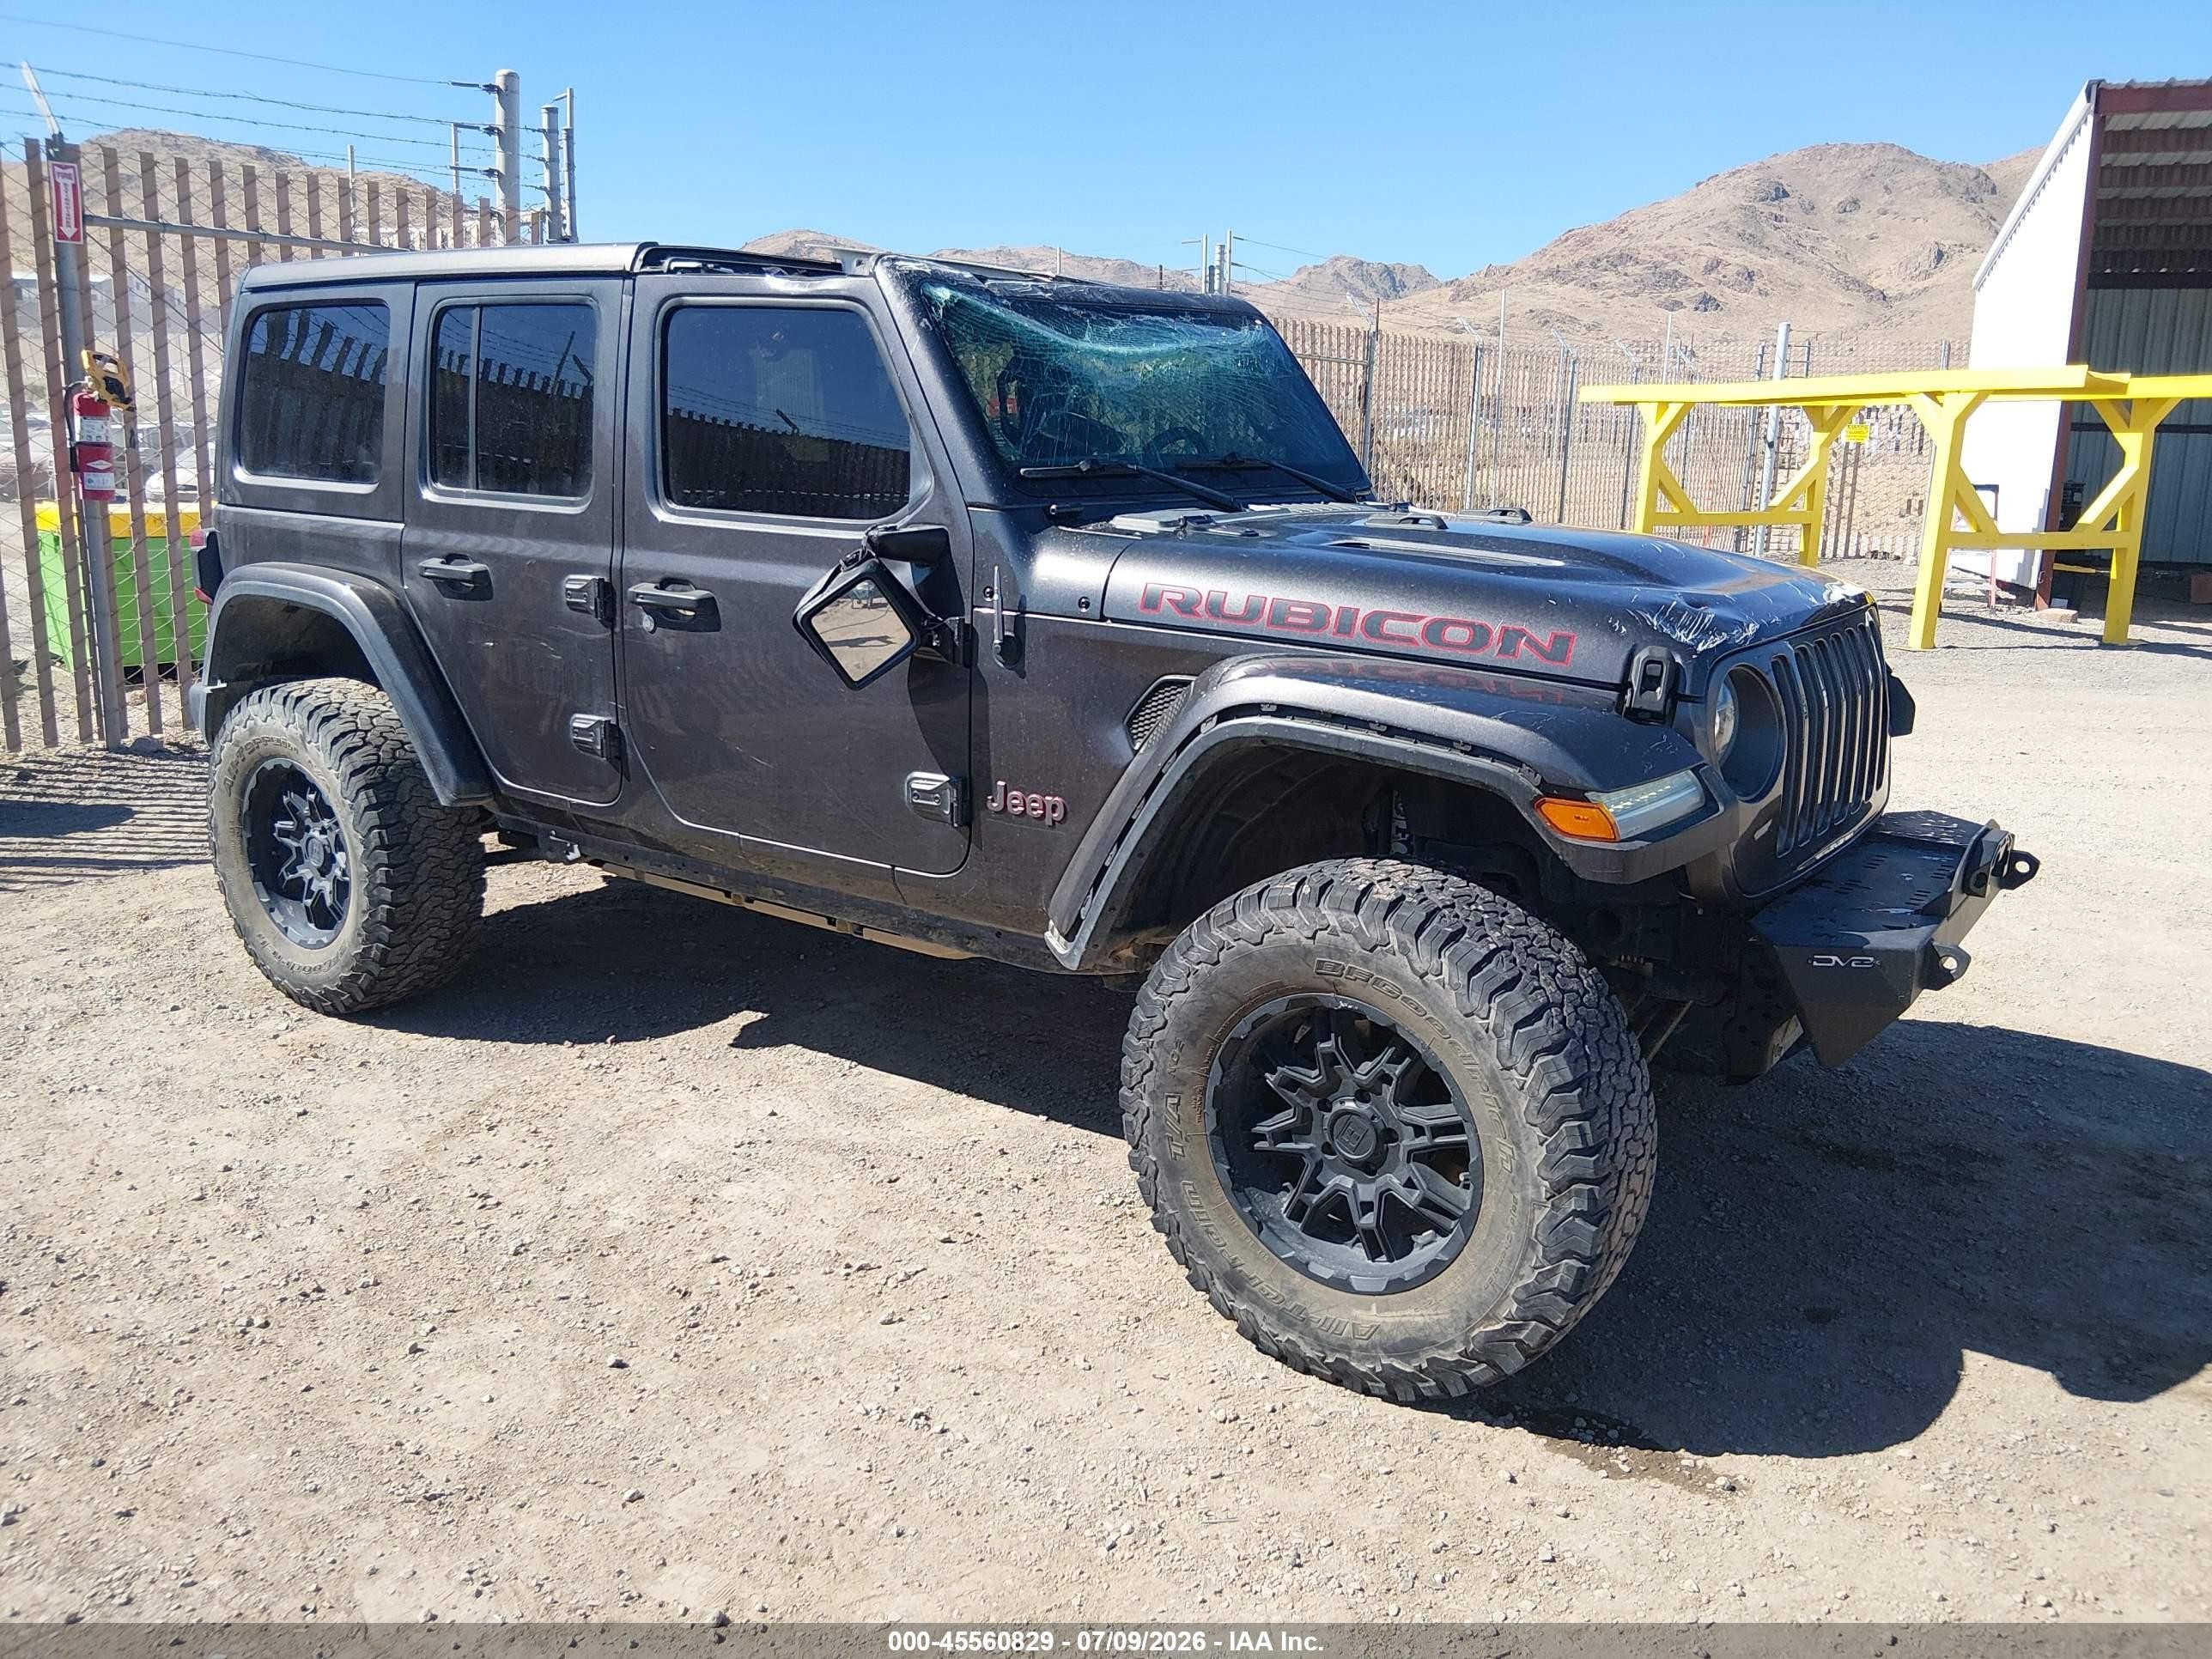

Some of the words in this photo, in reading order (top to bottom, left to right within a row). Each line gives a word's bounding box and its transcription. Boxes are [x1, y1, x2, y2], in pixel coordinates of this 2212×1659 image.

[1139, 581, 1577, 666] RUBICON
[987, 781, 1066, 826] Jeep
[1314, 957, 1515, 1174] BFGoodrich
